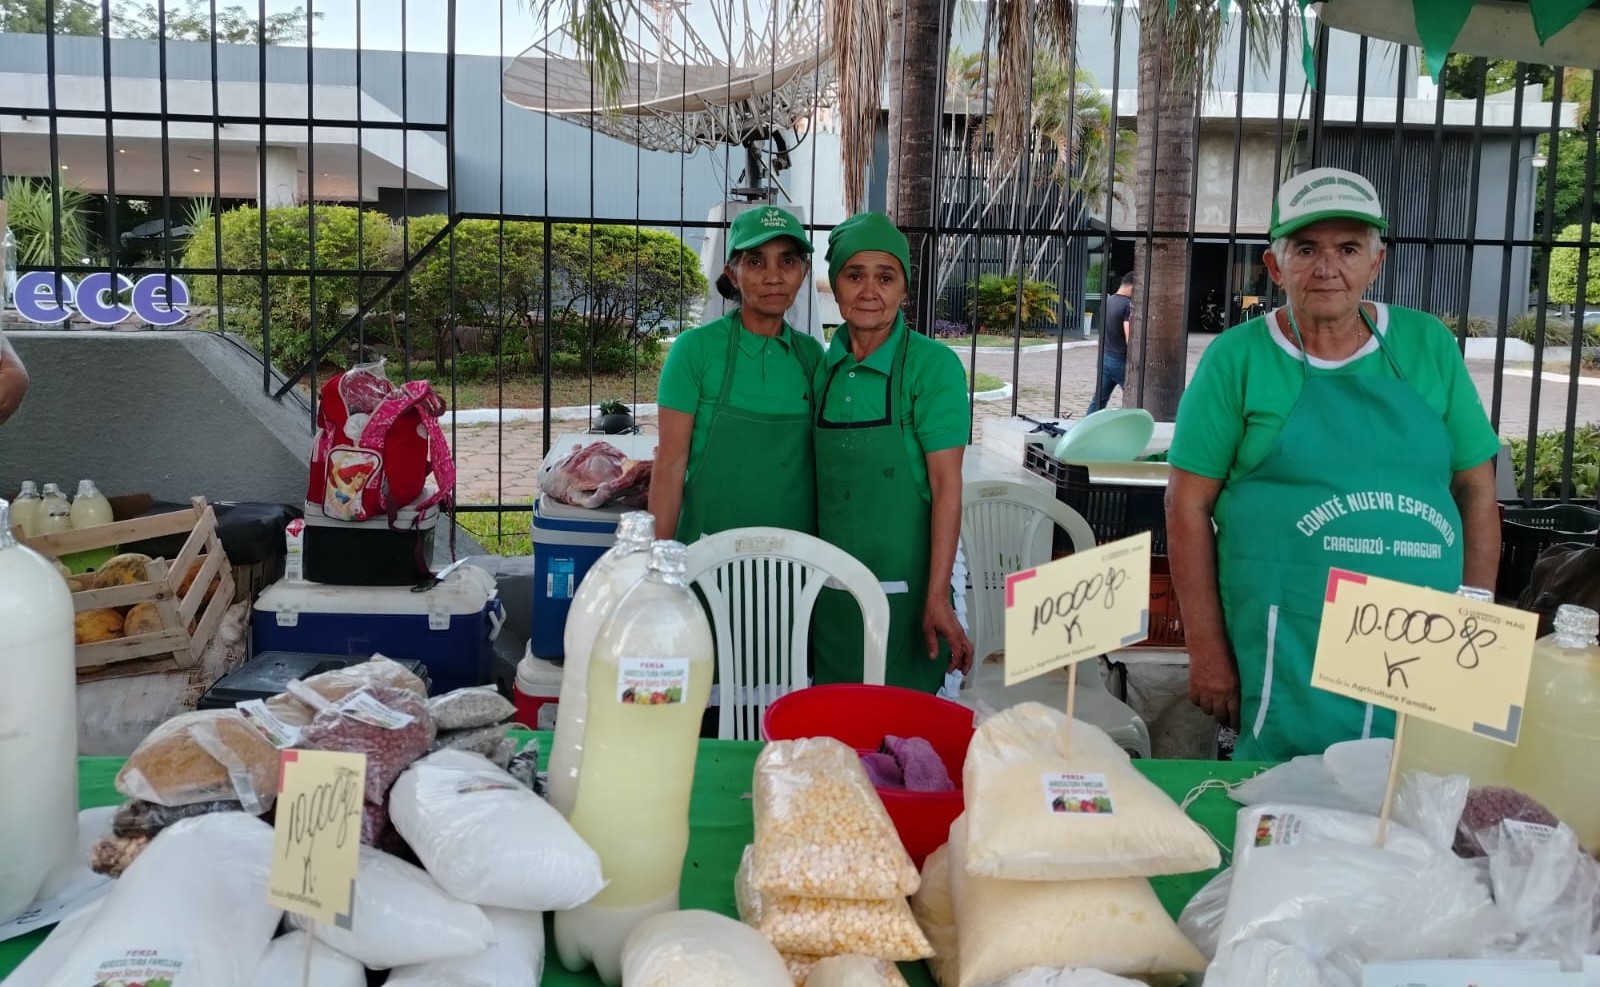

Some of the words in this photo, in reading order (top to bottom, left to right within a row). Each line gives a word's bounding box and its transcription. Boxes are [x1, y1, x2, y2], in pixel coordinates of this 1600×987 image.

[1296, 494, 1348, 537] COMITÉ
[1346, 491, 1395, 512] NUEVA
[1398, 494, 1456, 547] ESPERANZA
[1323, 535, 1384, 555] CAAGUAZÚ
[1393, 540, 1442, 559] PARAGUAY
[1345, 603, 1456, 644] 10.000
[1383, 650, 1421, 689] K
[1351, 682, 1400, 702] Agricultura
[1400, 696, 1438, 713] Familiar
